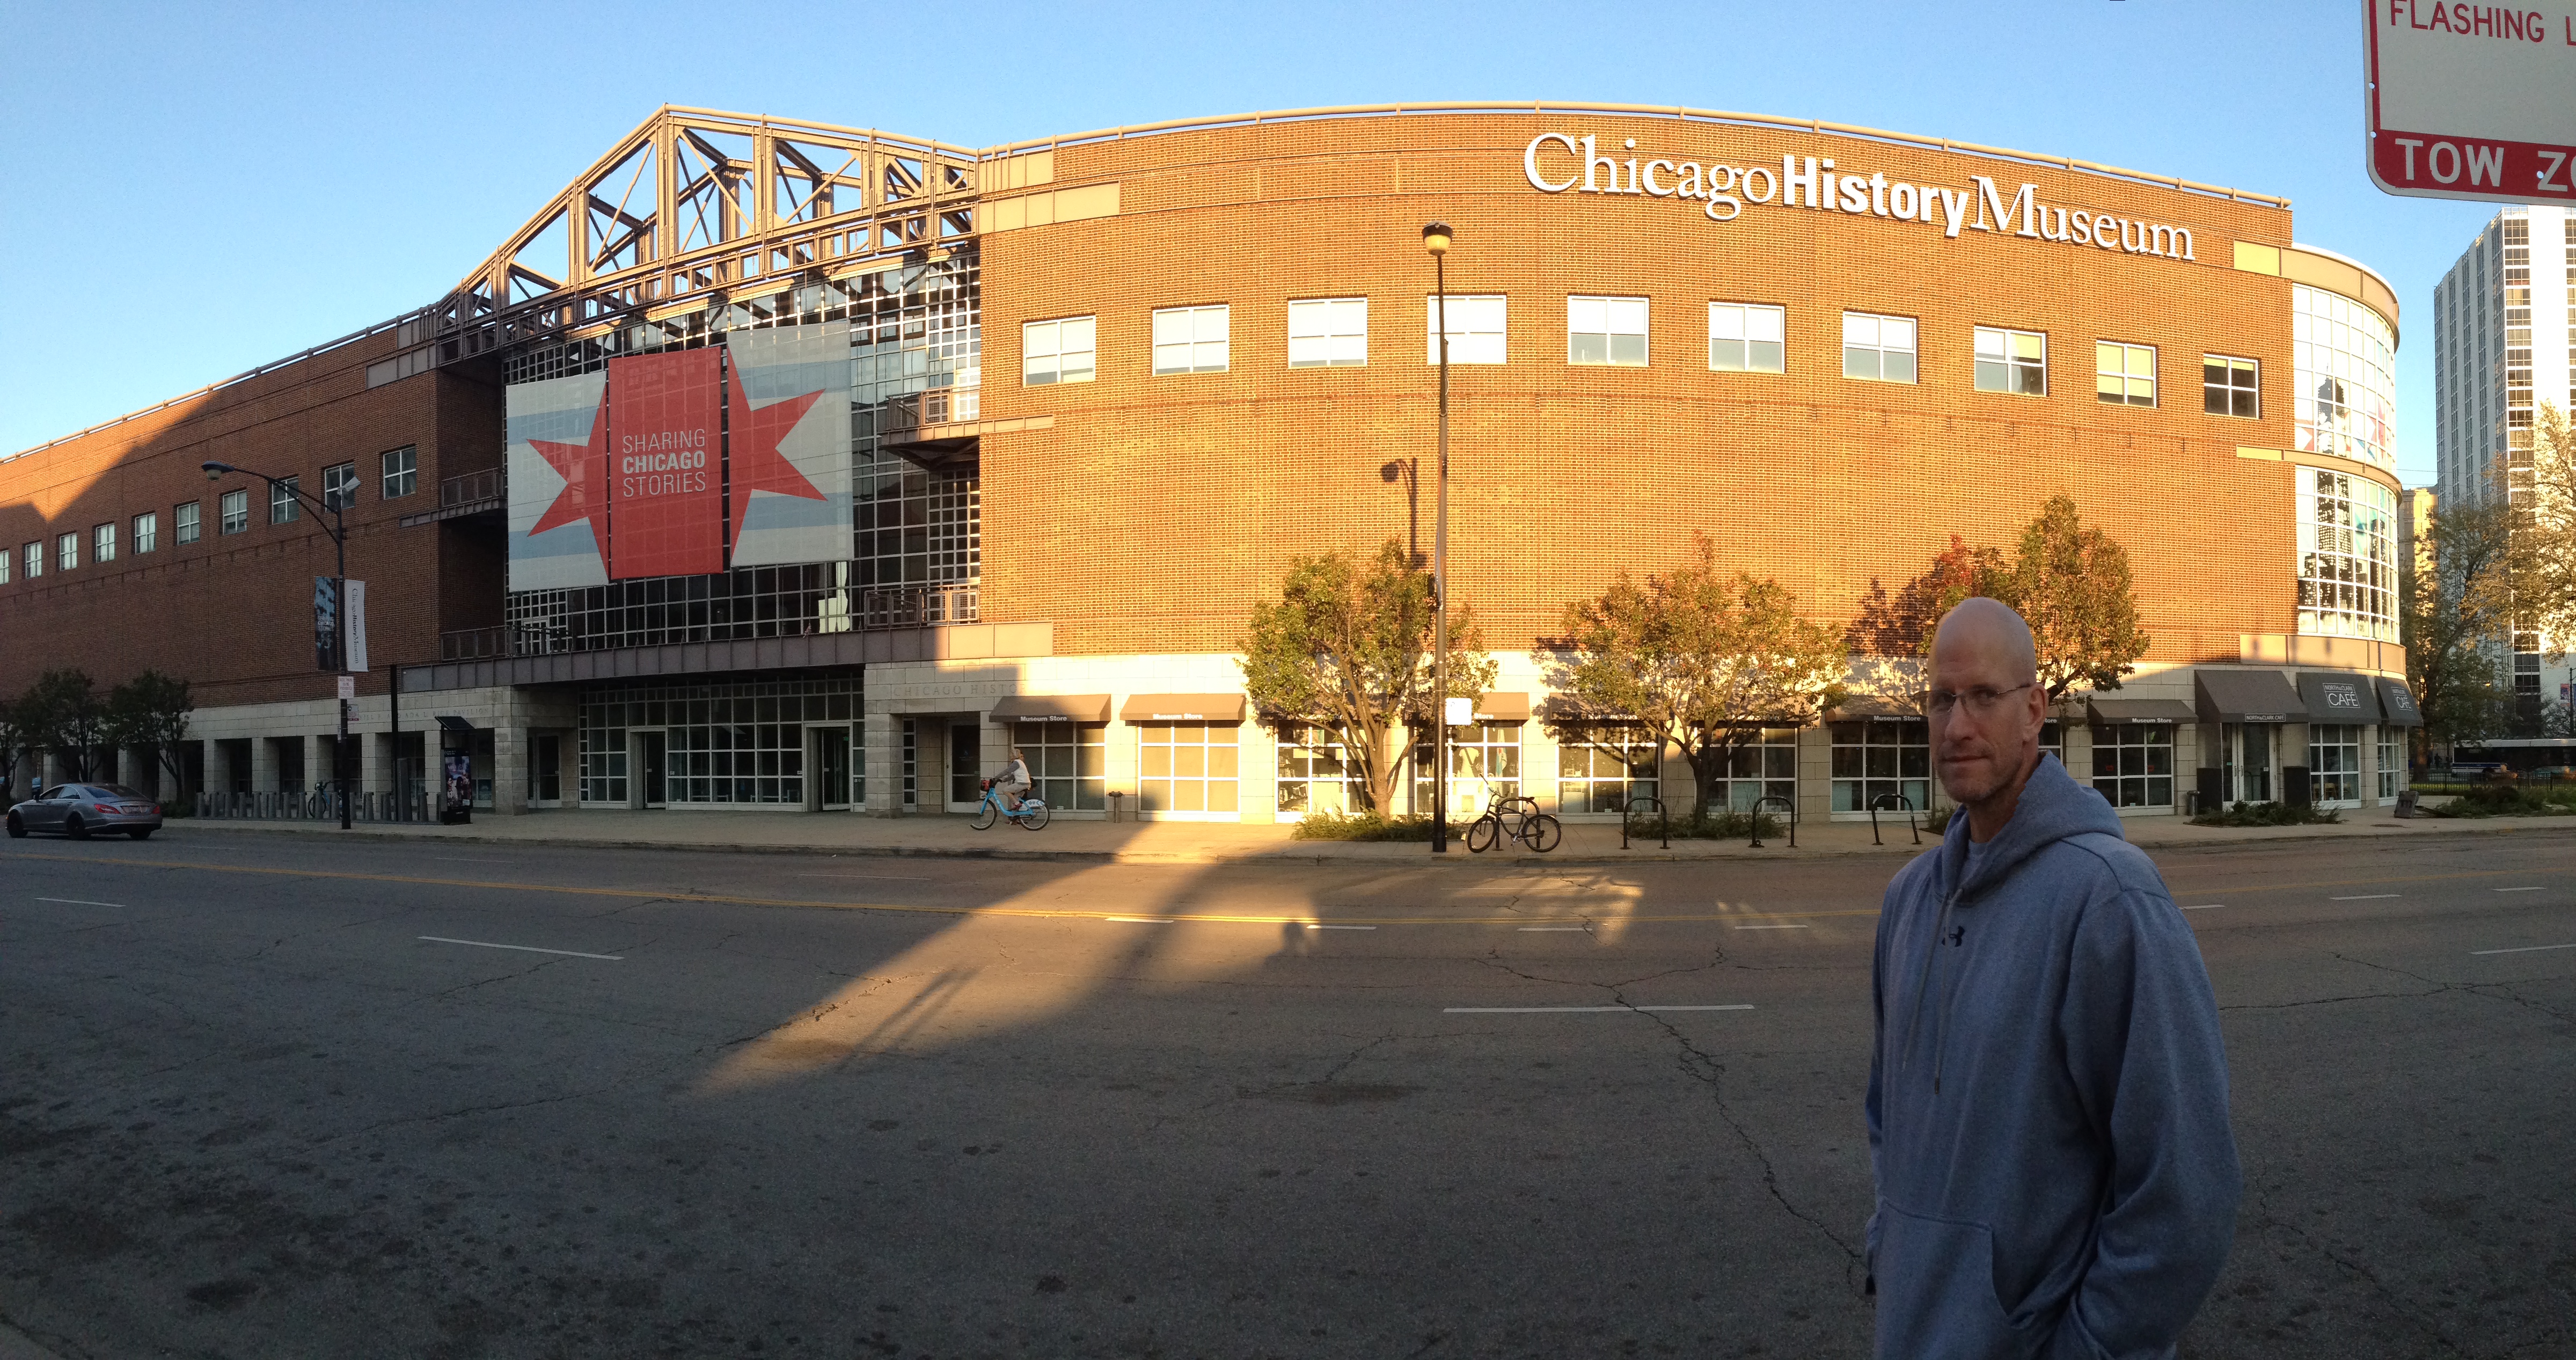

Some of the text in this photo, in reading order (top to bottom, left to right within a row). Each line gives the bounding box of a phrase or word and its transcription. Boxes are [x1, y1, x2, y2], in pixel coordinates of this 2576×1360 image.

[2390, 0, 2544, 42] FLASHING
[2395, 138, 2576, 192] TOW Z
[623, 428, 705, 454] SHARING
[622, 449, 705, 474] CHICAGO
[623, 471, 706, 498] STORIES
[893, 685, 961, 696] CHICAGO
[2328, 691, 2358, 706] CAFÉ
